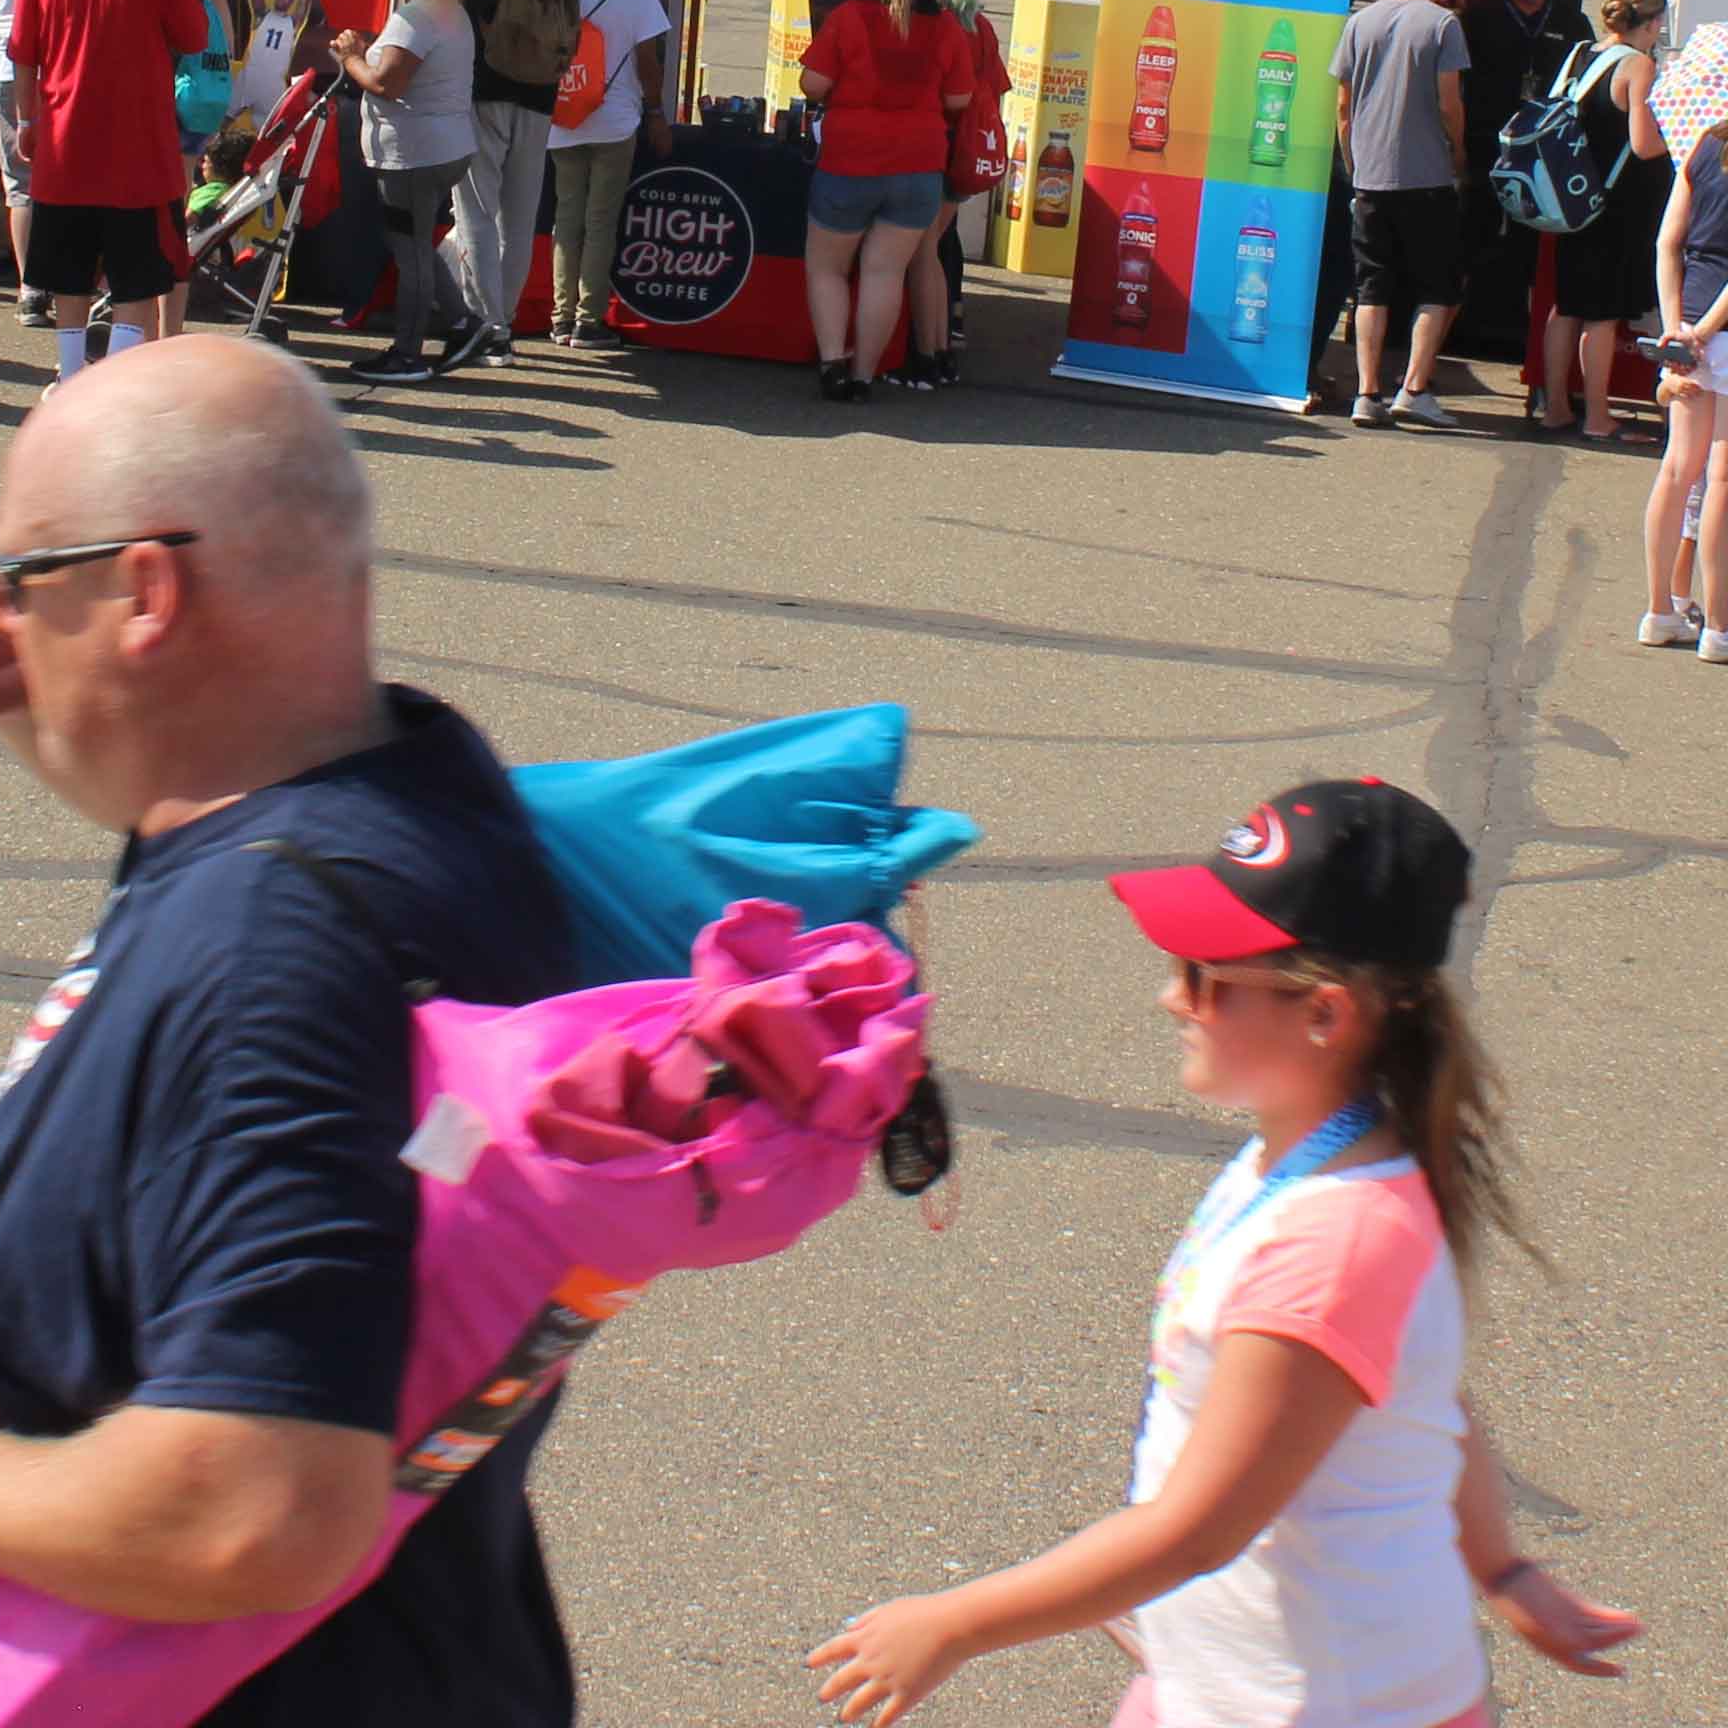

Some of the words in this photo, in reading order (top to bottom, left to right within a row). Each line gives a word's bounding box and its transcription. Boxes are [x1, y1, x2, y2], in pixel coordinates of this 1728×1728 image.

[265, 28, 283, 50] 11
[1138, 54, 1175, 67] SLEEP
[1258, 68, 1294, 81] DAILY
[1136, 105, 1166, 116] neuro
[1255, 120, 1286, 131] neuro
[640, 190, 676, 201] COLD
[683, 194, 721, 206] BREW
[625, 205, 735, 245] HIGH
[1119, 229, 1157, 245] SONIC
[1237, 244, 1275, 258] BLISS
[618, 241, 733, 277] Brew
[635, 282, 709, 301] COFFEE
[1117, 281, 1148, 292] neuro
